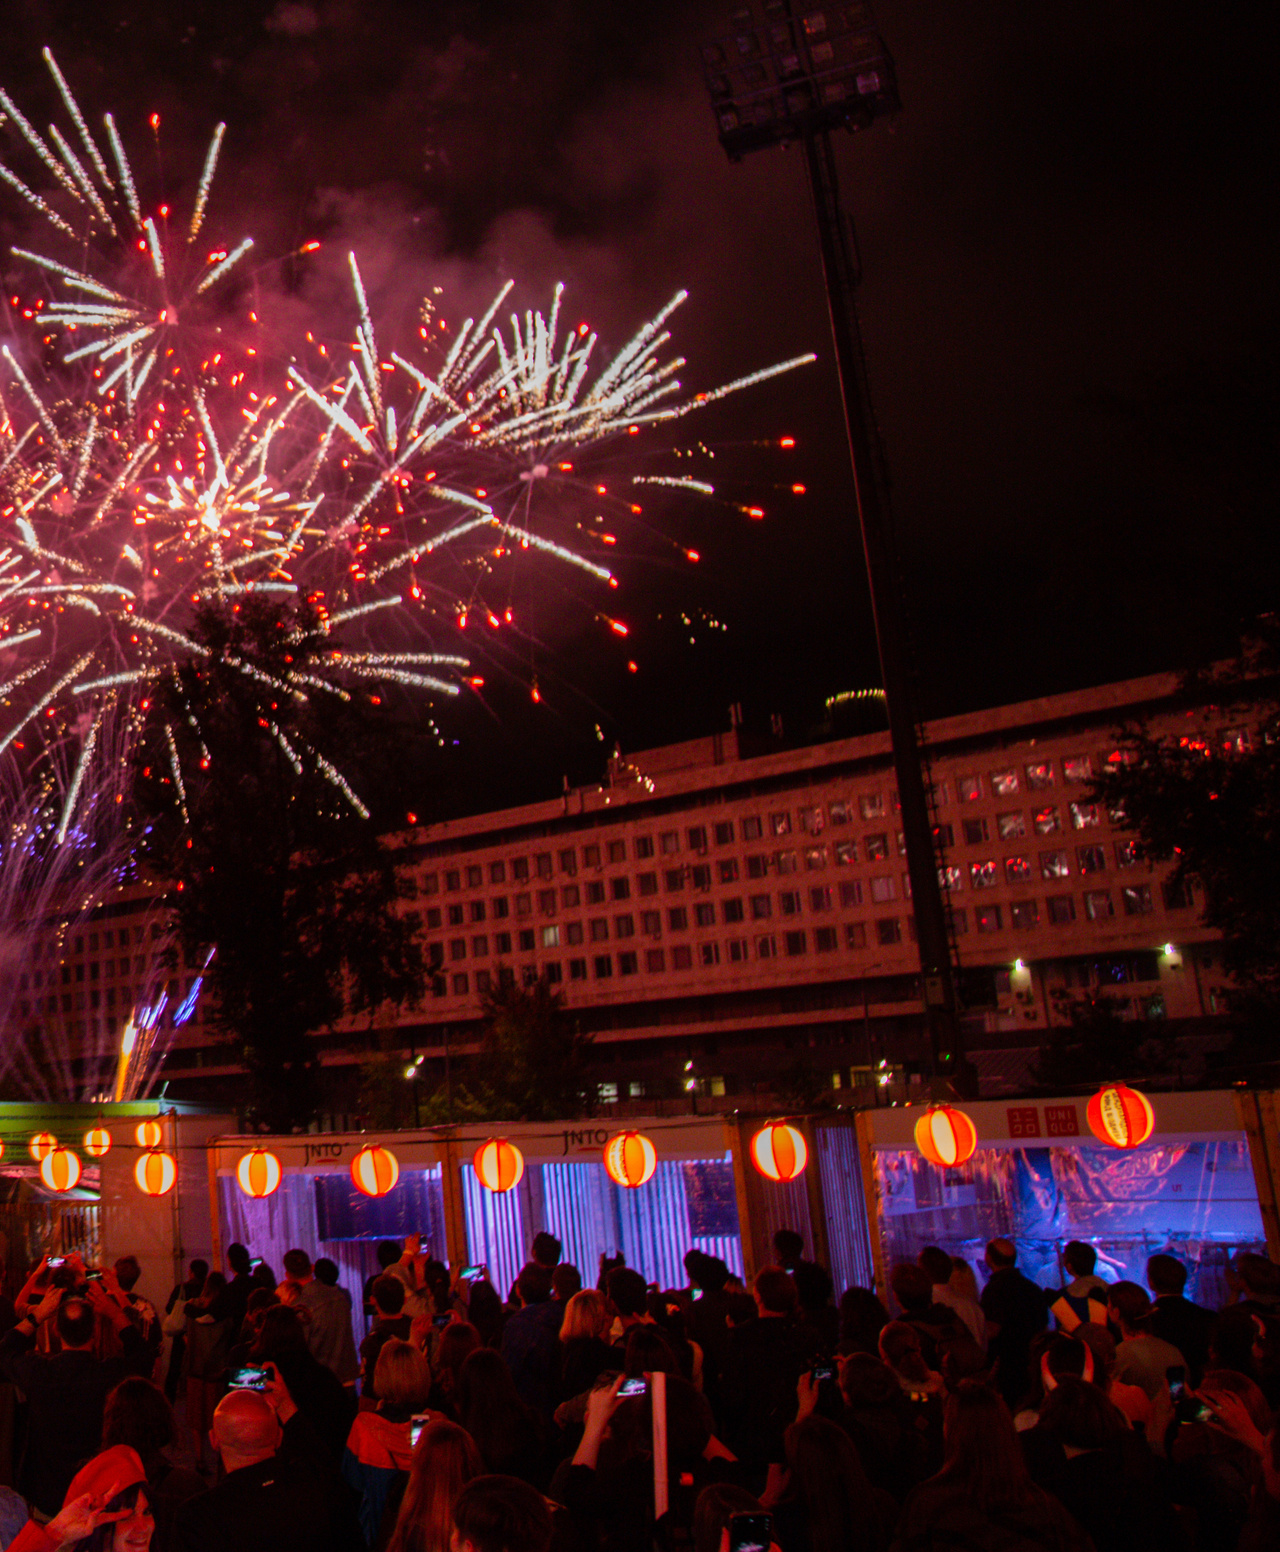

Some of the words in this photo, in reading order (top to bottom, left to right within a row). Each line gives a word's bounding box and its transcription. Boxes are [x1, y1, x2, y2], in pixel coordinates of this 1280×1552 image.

[1048, 1110, 1072, 1120] UNI
[1050, 1123, 1075, 1133] QLO
[563, 1129, 609, 1156] JNTO
[304, 1143, 342, 1167] JNTO
